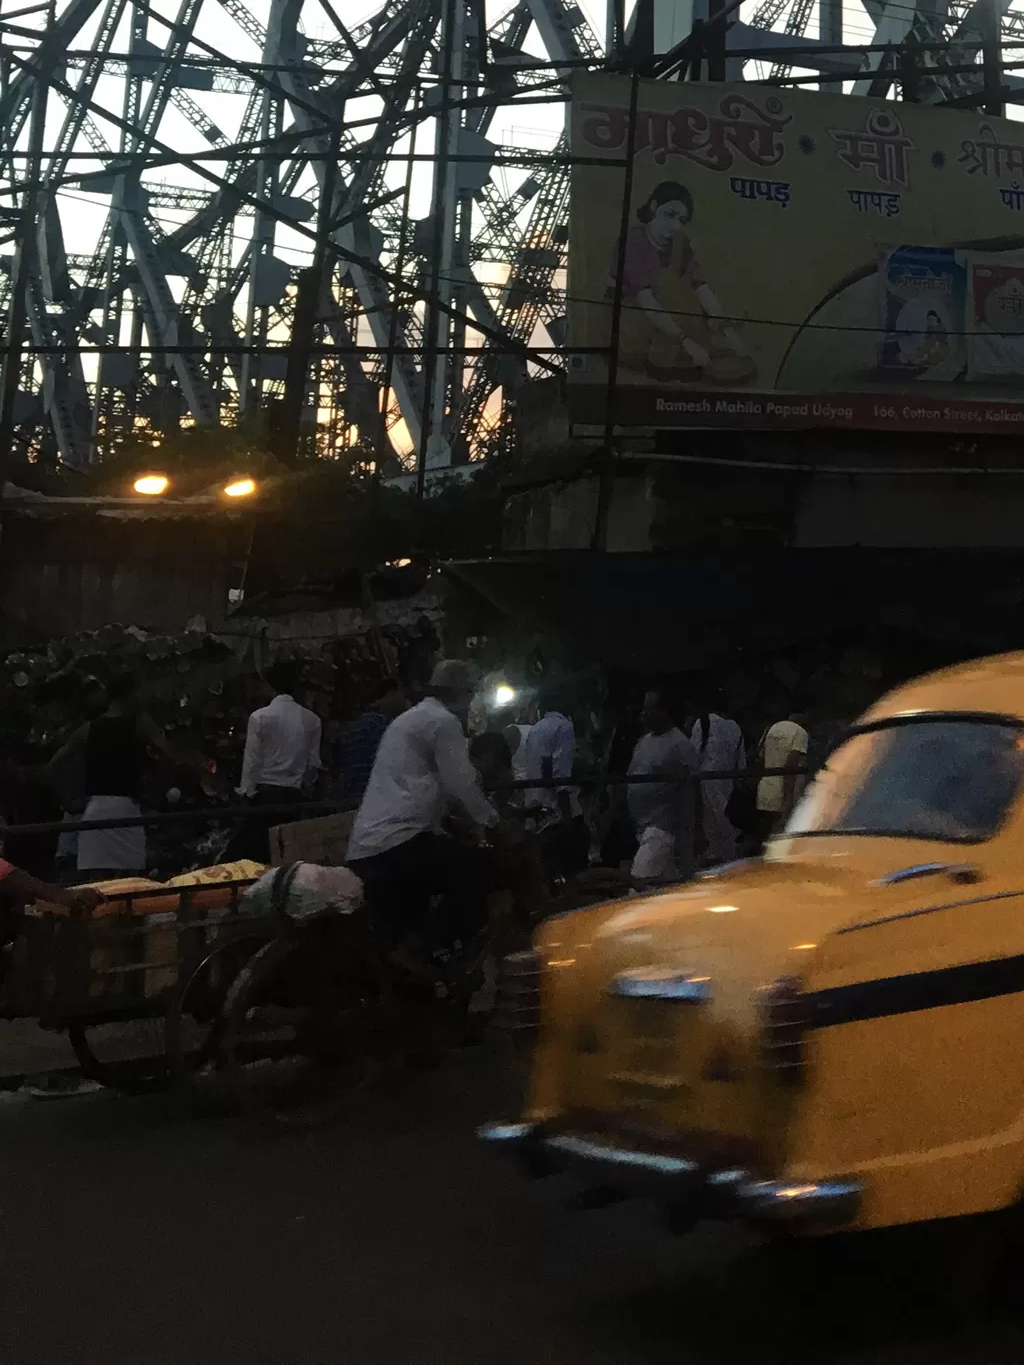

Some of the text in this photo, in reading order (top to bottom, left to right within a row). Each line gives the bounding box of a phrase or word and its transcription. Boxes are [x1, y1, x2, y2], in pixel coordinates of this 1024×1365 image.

[729, 177, 791, 208] पापड़
[847, 188, 901, 217] पापड़
[656, 398, 853, 419] Ramesh Mahila Papad Udyog
[902, 406, 941, 419] Cotton
